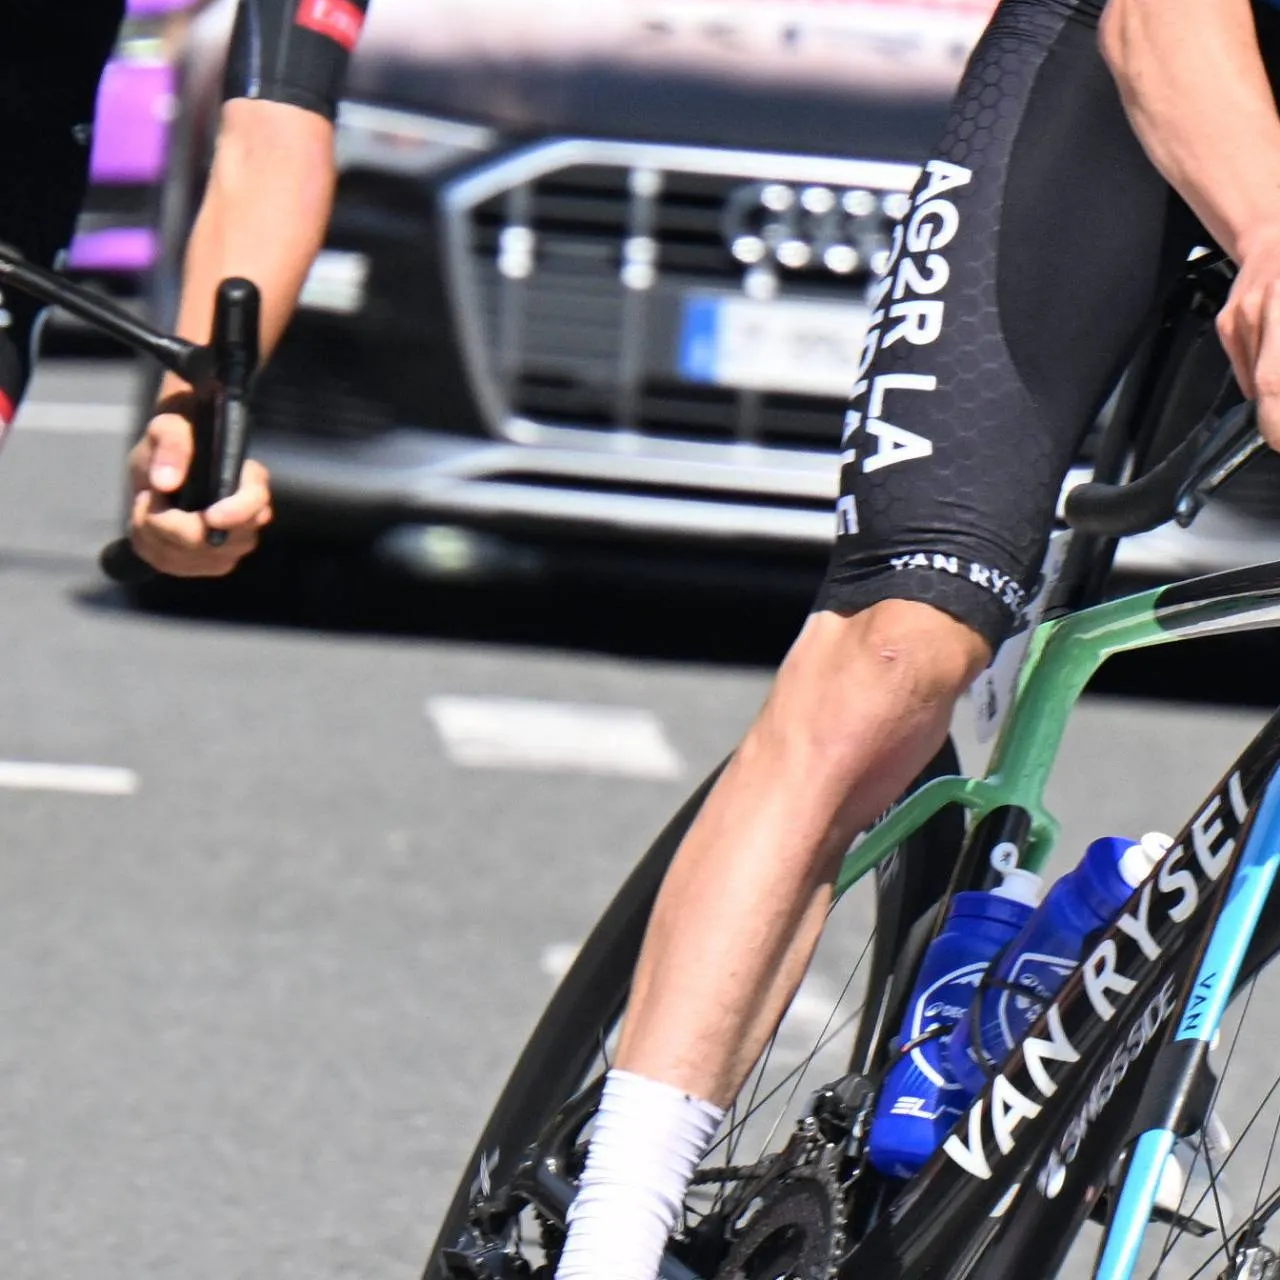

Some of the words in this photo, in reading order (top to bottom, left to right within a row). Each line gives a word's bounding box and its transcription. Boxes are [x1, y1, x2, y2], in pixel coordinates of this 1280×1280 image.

[880, 158, 974, 351] AG2R
[861, 373, 938, 474] LA
[889, 552, 959, 574] VAN
[1182, 972, 1217, 1032] VAN
[942, 1001, 1082, 1181] VAN
